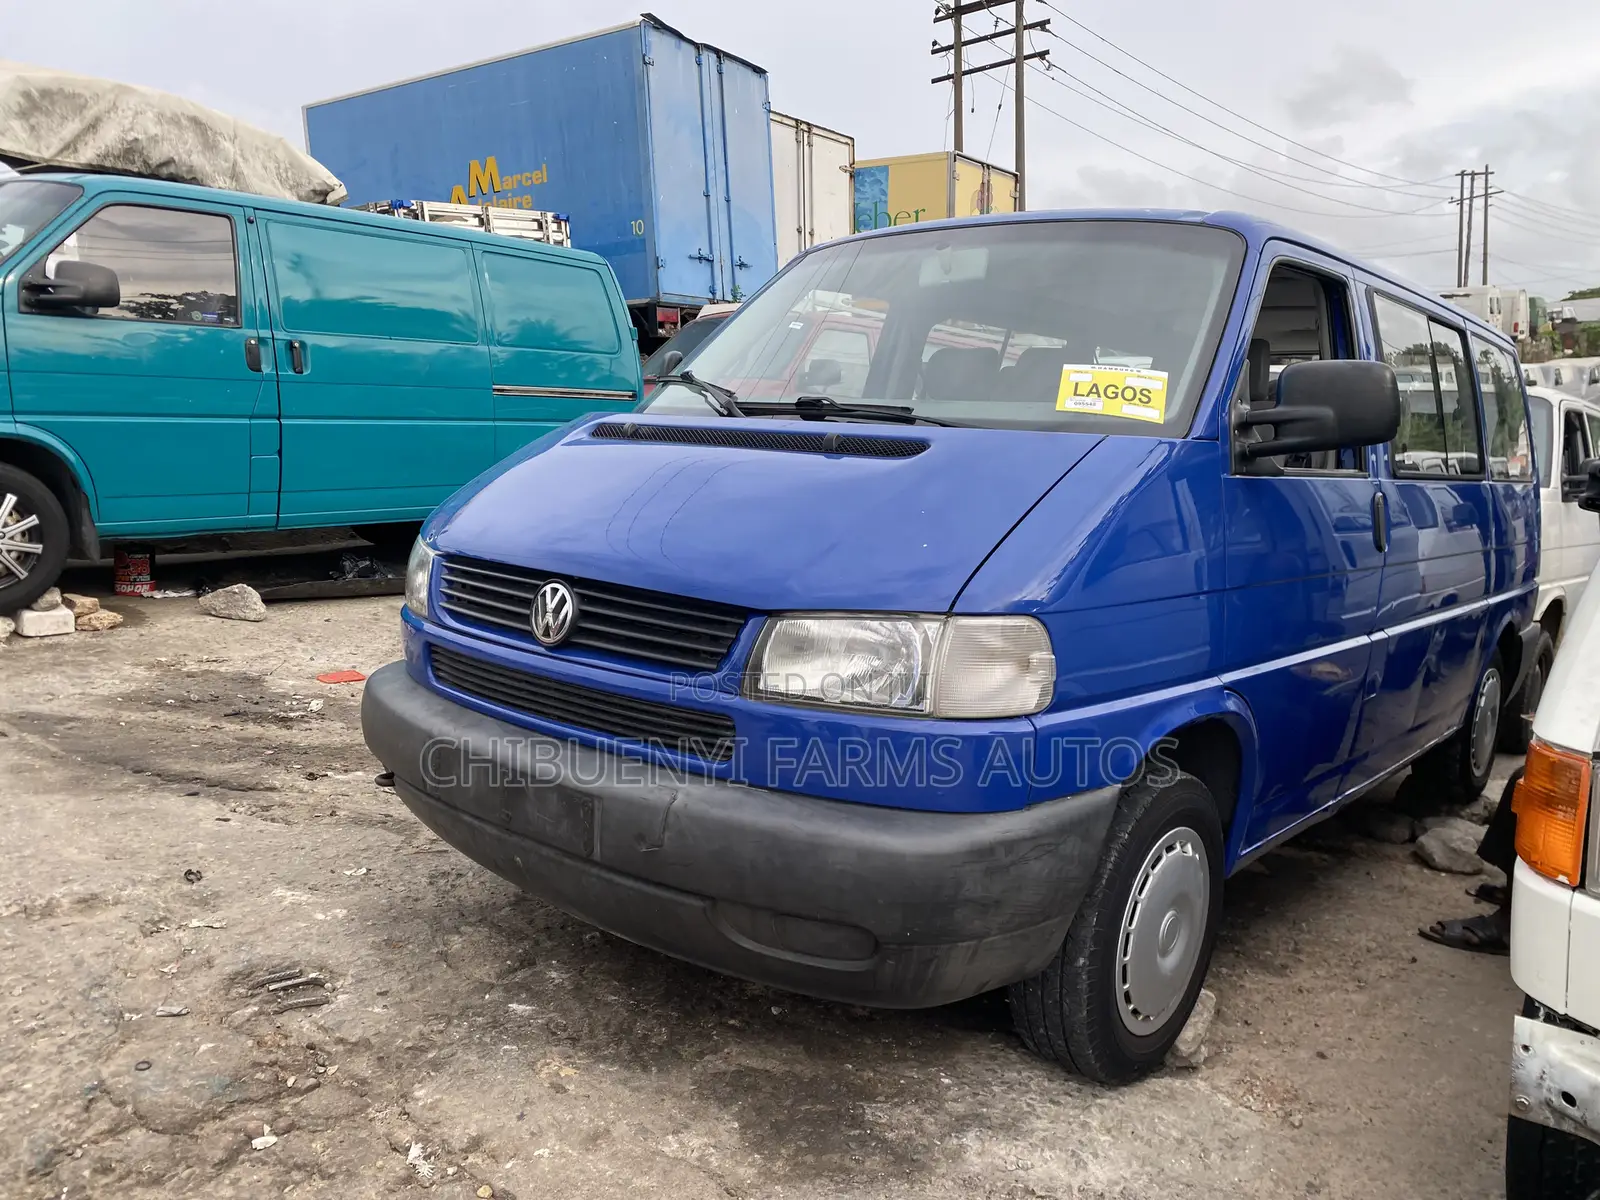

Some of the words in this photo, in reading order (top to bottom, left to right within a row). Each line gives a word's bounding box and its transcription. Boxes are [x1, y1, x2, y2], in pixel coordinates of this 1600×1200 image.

[468, 156, 548, 198] Marcel
[631, 219, 645, 236] 10
[1073, 382, 1152, 405] LAGOS
